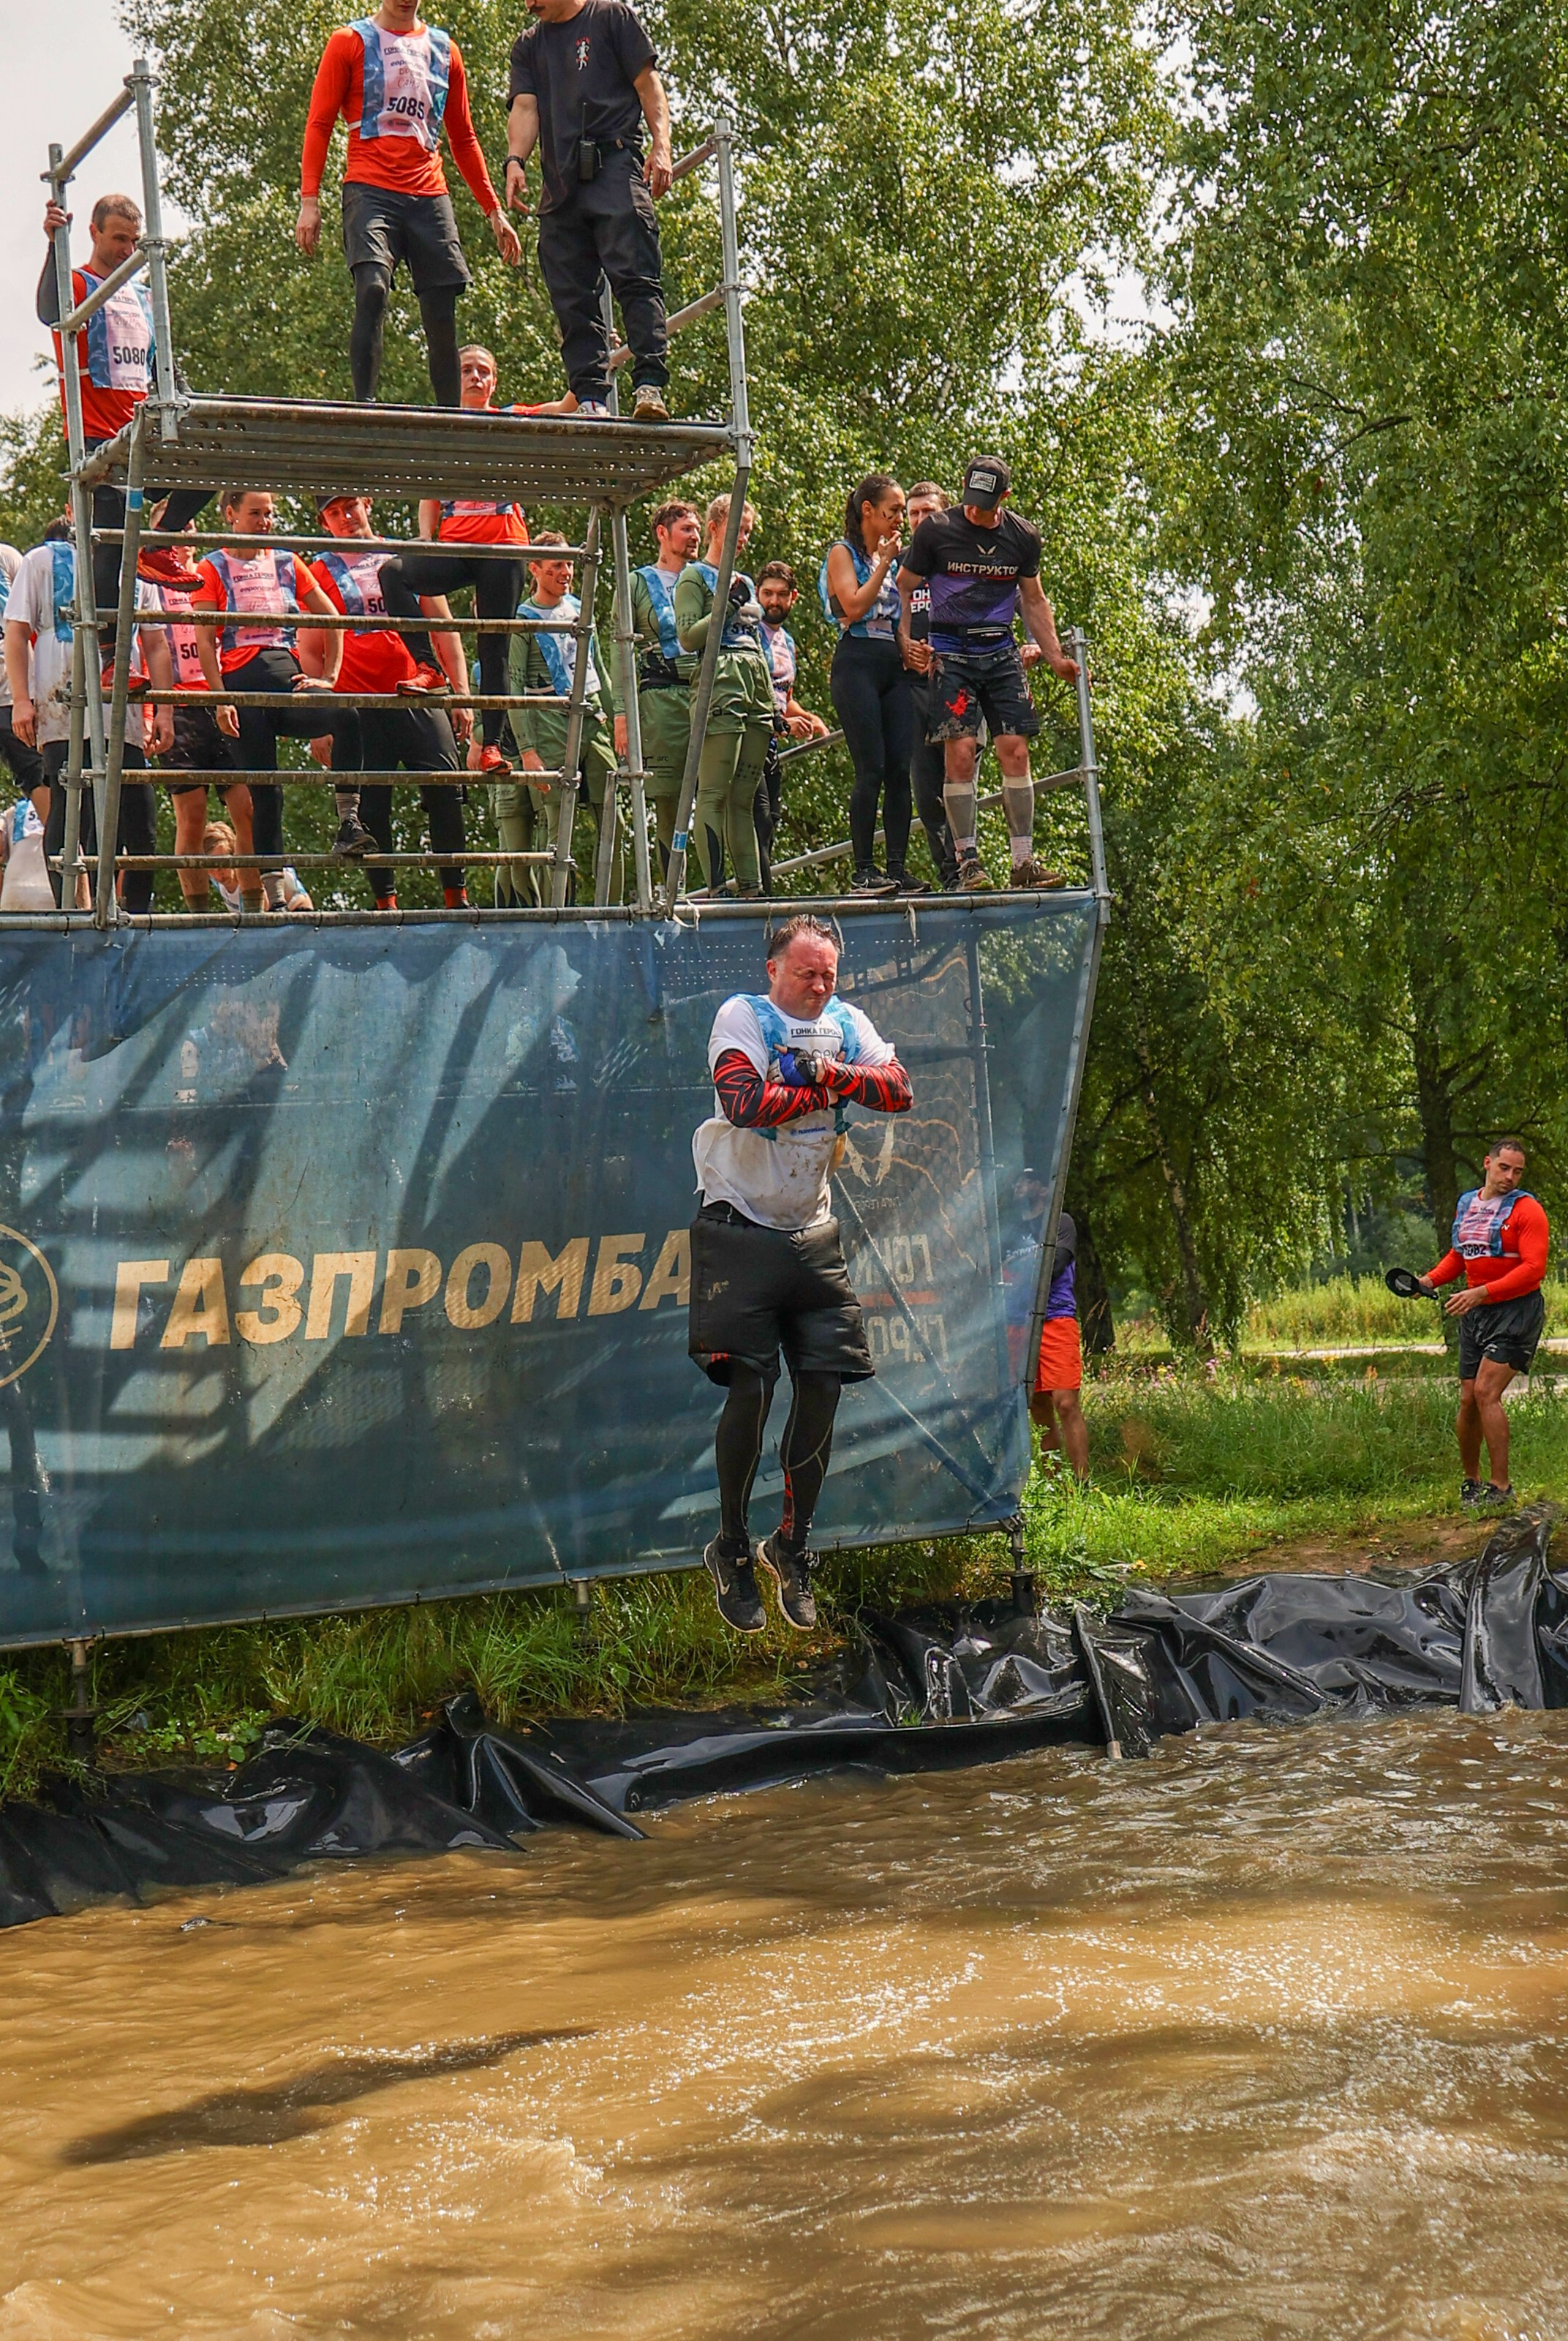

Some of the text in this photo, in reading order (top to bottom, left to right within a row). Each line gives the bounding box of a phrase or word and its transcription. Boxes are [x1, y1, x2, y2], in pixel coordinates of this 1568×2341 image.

[386, 97, 424, 120] 5085
[113, 346, 146, 365] 5080
[368, 597, 386, 613] 50
[911, 600, 931, 613] ЕРО
[180, 642, 198, 660] 50
[110, 1229, 690, 1350] ГАЗПРОМБА
